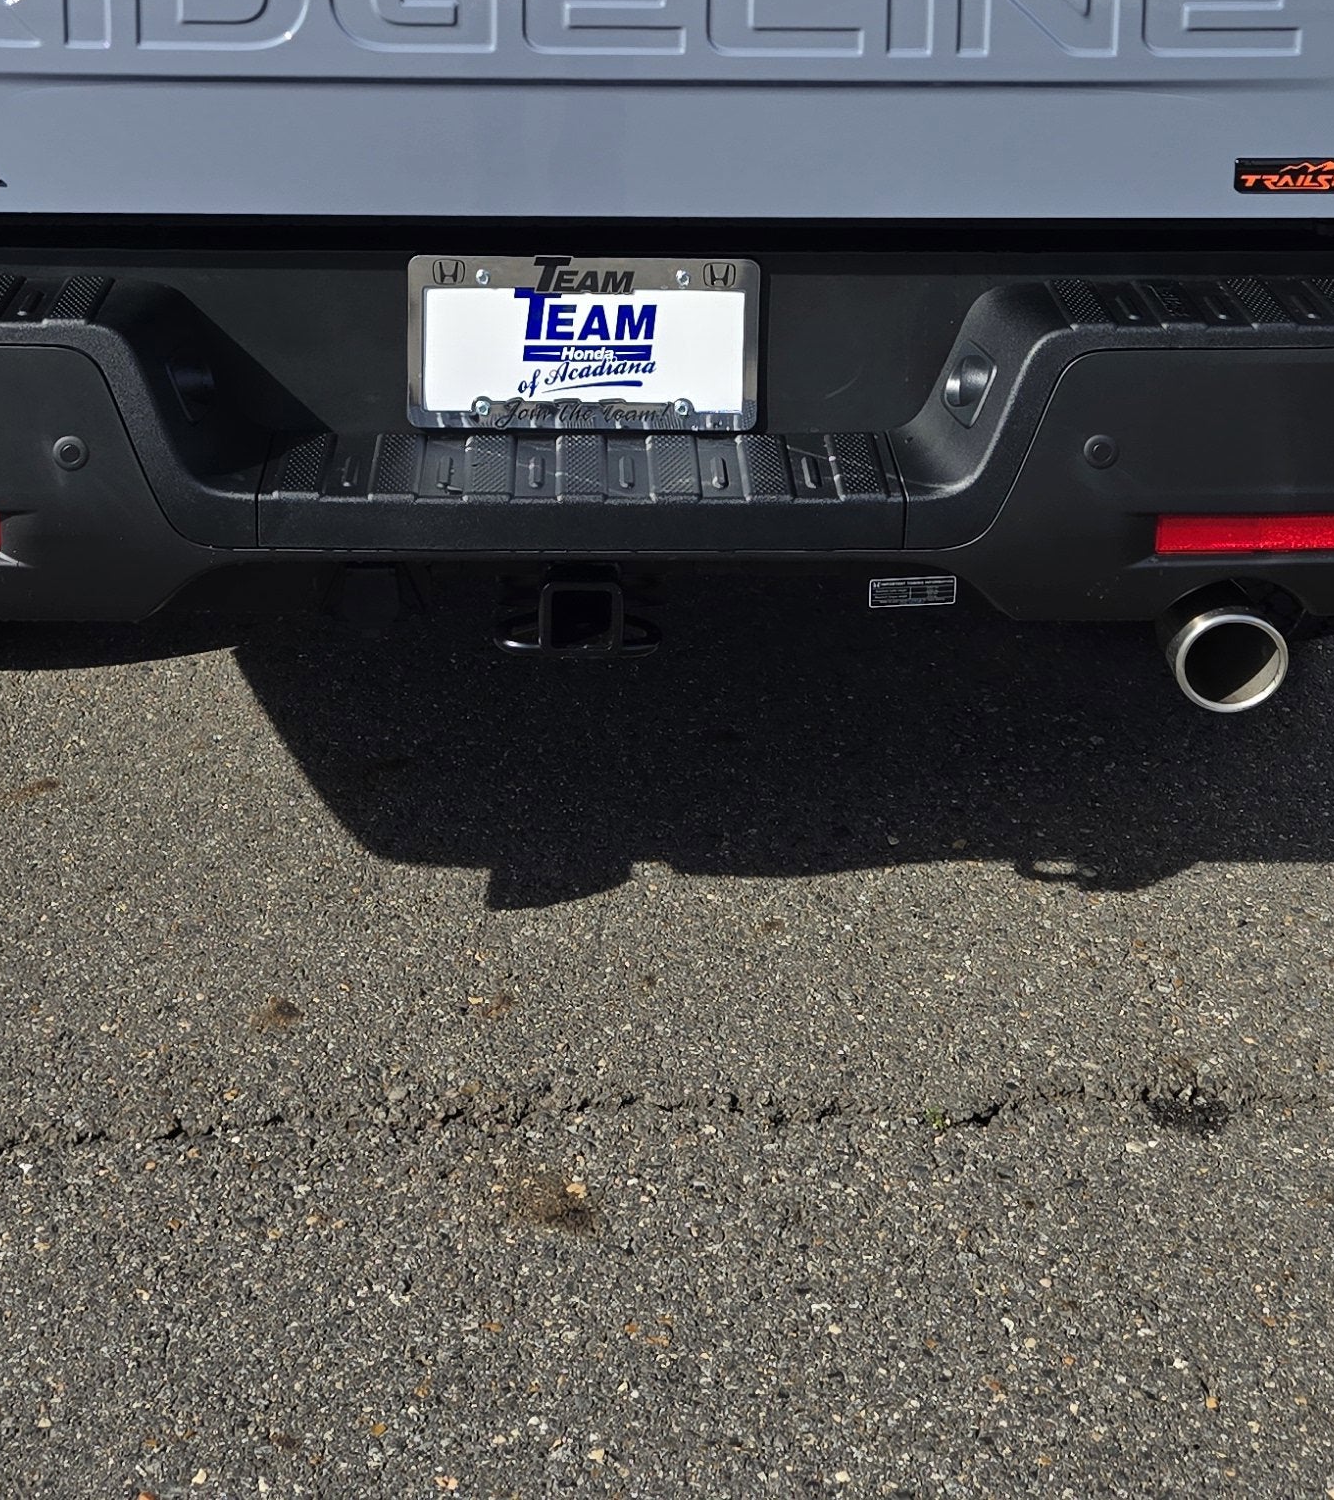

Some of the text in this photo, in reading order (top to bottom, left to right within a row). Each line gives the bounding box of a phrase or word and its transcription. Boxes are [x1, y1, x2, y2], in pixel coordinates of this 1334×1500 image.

[533, 257, 635, 293] TEAM
[514, 287, 657, 340] TEAM
[560, 346, 615, 361] Honda
[517, 357, 657, 398] of Acadiana
[495, 397, 551, 429] Join
[554, 398, 596, 423] The
